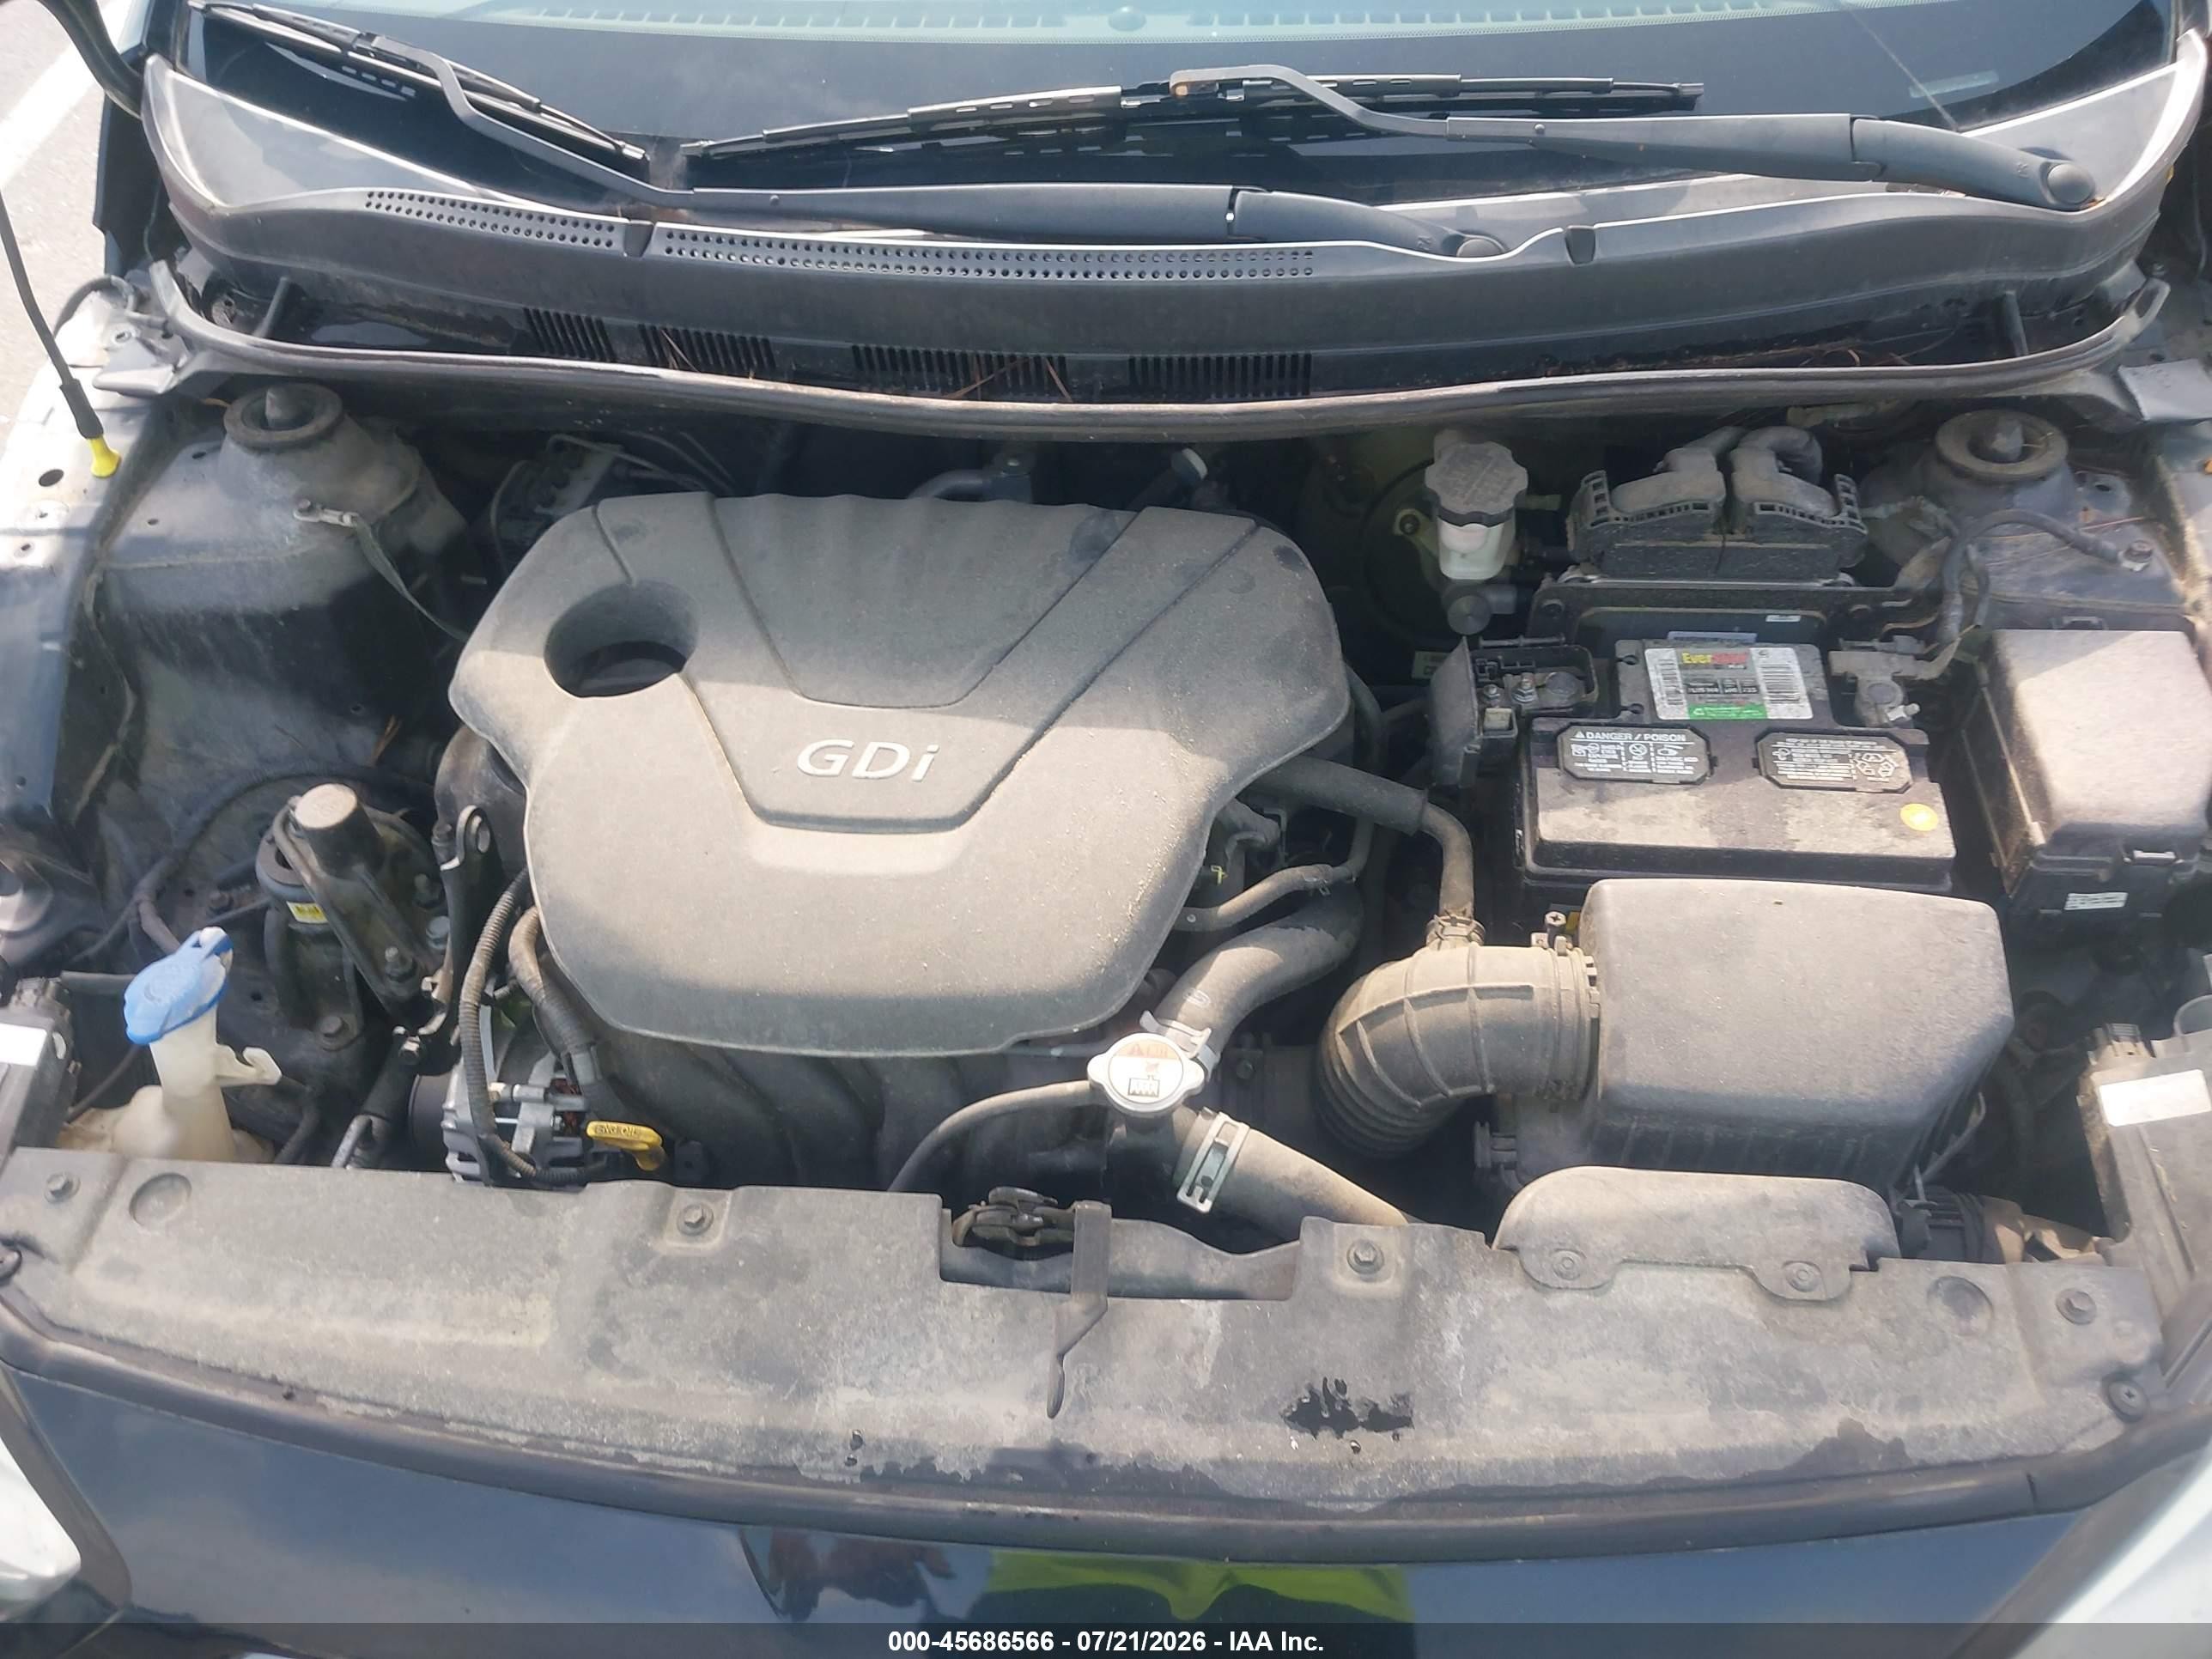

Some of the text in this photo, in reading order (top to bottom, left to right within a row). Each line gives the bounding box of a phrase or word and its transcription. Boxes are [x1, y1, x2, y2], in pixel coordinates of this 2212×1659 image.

[1585, 731, 1632, 740] DANGER
[1644, 733, 1686, 742] POISON
[797, 738, 940, 783] GDi
